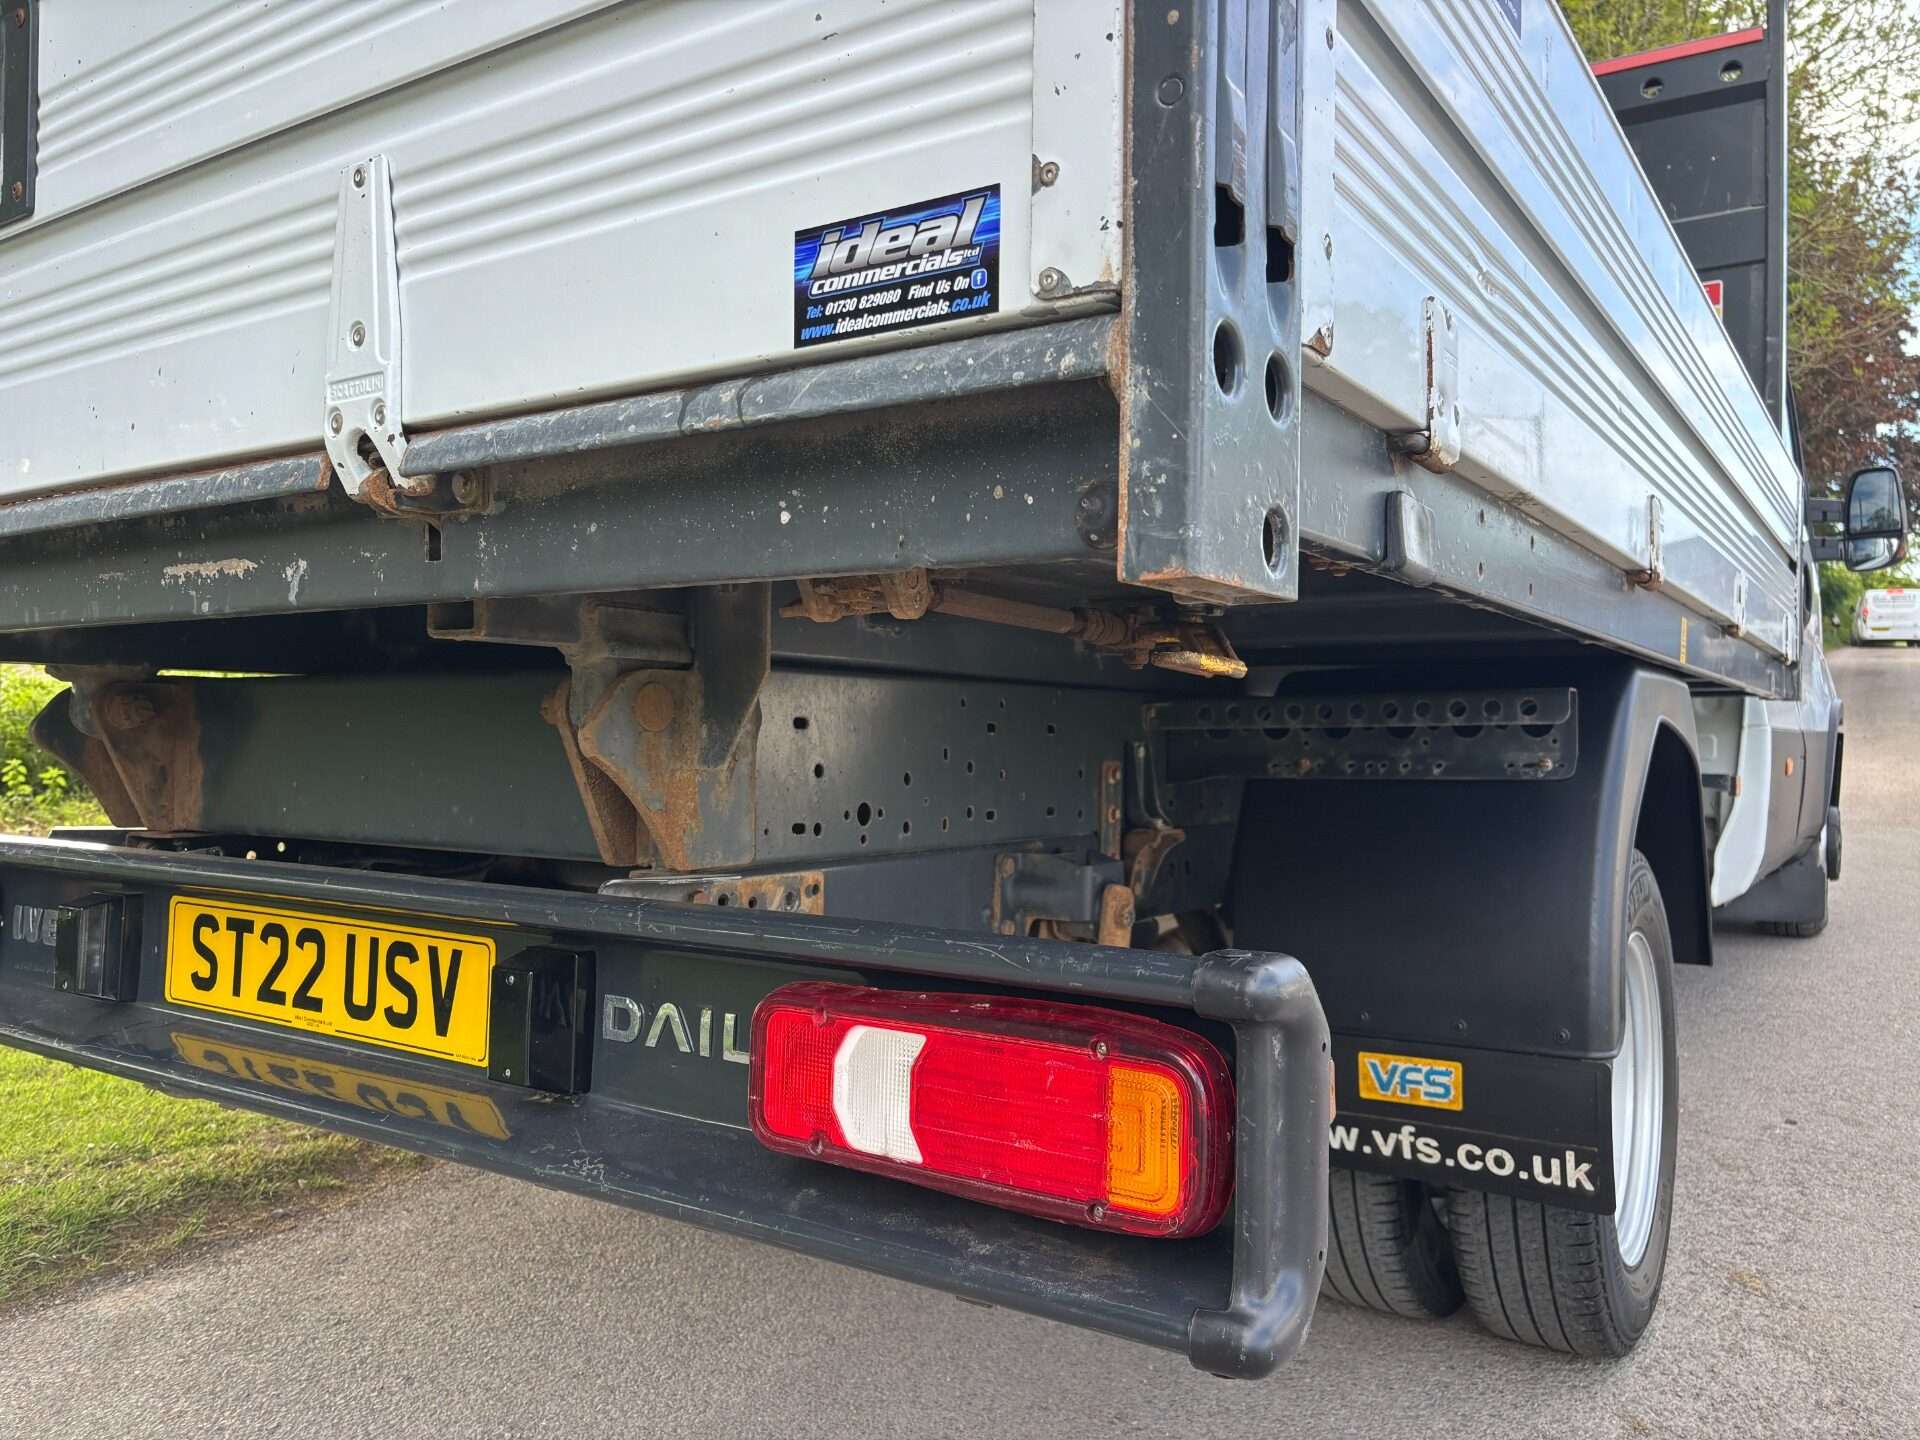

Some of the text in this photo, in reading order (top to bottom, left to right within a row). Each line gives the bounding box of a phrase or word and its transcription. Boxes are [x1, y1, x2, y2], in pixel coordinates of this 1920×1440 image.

[811, 194, 989, 278] ideal
[806, 305, 823, 319] Tel:
[825, 299, 857, 316] 01730
[859, 290, 901, 308] 829080
[908, 284, 932, 300] Find
[936, 280, 952, 294] Us
[953, 276, 970, 291] On
[811, 249, 963, 295] commercials
[800, 290, 991, 340] www.idealcommercials.co.uk
[191, 913, 463, 1038] ST22 USV
[602, 994, 750, 1065] DAIL
[1365, 1059, 1455, 1102] VFS
[1329, 1124, 1596, 1192] w.vfs.co.uk
